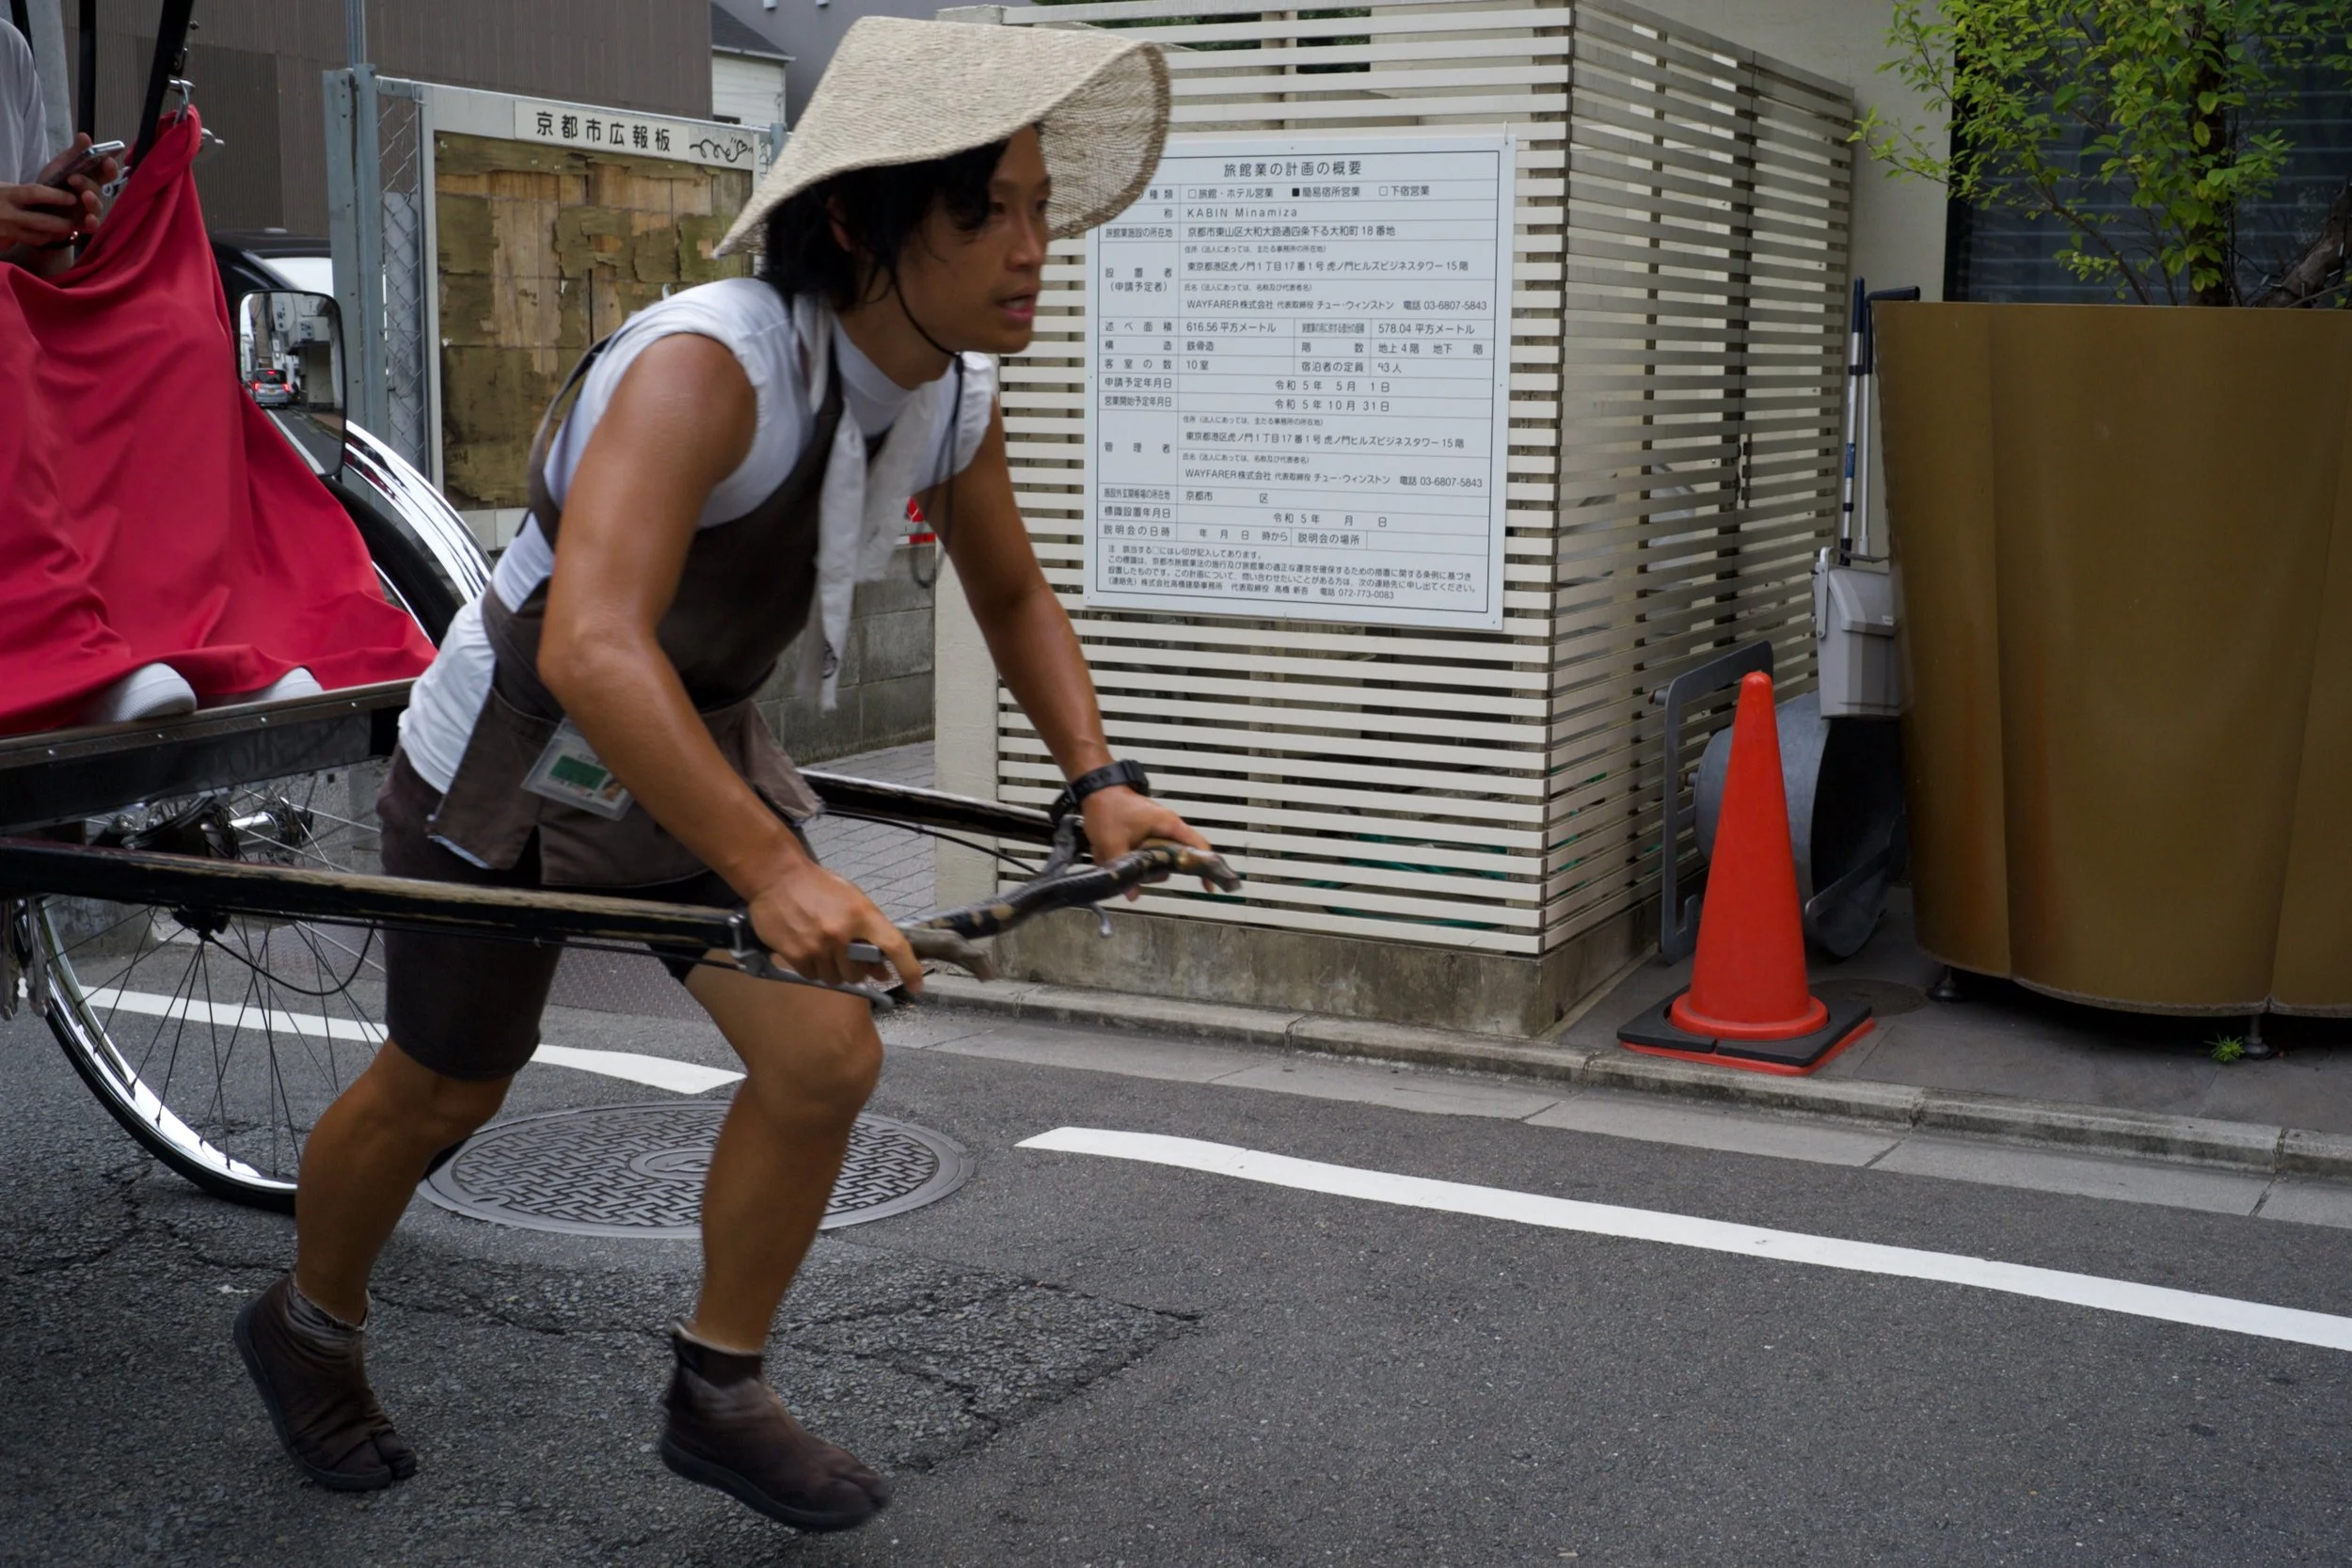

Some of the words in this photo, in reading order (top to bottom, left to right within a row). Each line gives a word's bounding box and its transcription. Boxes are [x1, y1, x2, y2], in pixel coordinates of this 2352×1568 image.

[535, 111, 671, 153] 京都市広報板
[1223, 161, 1362, 178] 旅館業の計画の概要
[1187, 209, 1229, 218] KABIN
[1234, 207, 1298, 218] Minamiza
[1423, 300, 1487, 311] 03-6807-5843
[1186, 341, 1215, 352] 鉄骨造
[1472, 343, 1484, 356] 階
[1301, 361, 1364, 373] 宿泊者の定員
[1104, 377, 1172, 388] 申請予定年月日
[1420, 477, 1484, 488] 03-6807-5843
[1185, 490, 1214, 501] 京都市
[1259, 493, 1269, 504] 区
[1104, 506, 1171, 518] 標識設置年月日
[1344, 515, 1354, 527] 月
[1378, 516, 1387, 528] 日
[1104, 524, 1171, 537] 説明会の日時
[1199, 528, 1208, 538] 年
[1219, 529, 1229, 539] 月
[1241, 530, 1250, 540] 日
[1262, 531, 1289, 542] 時から
[1297, 532, 1360, 546] 説明会の場所
